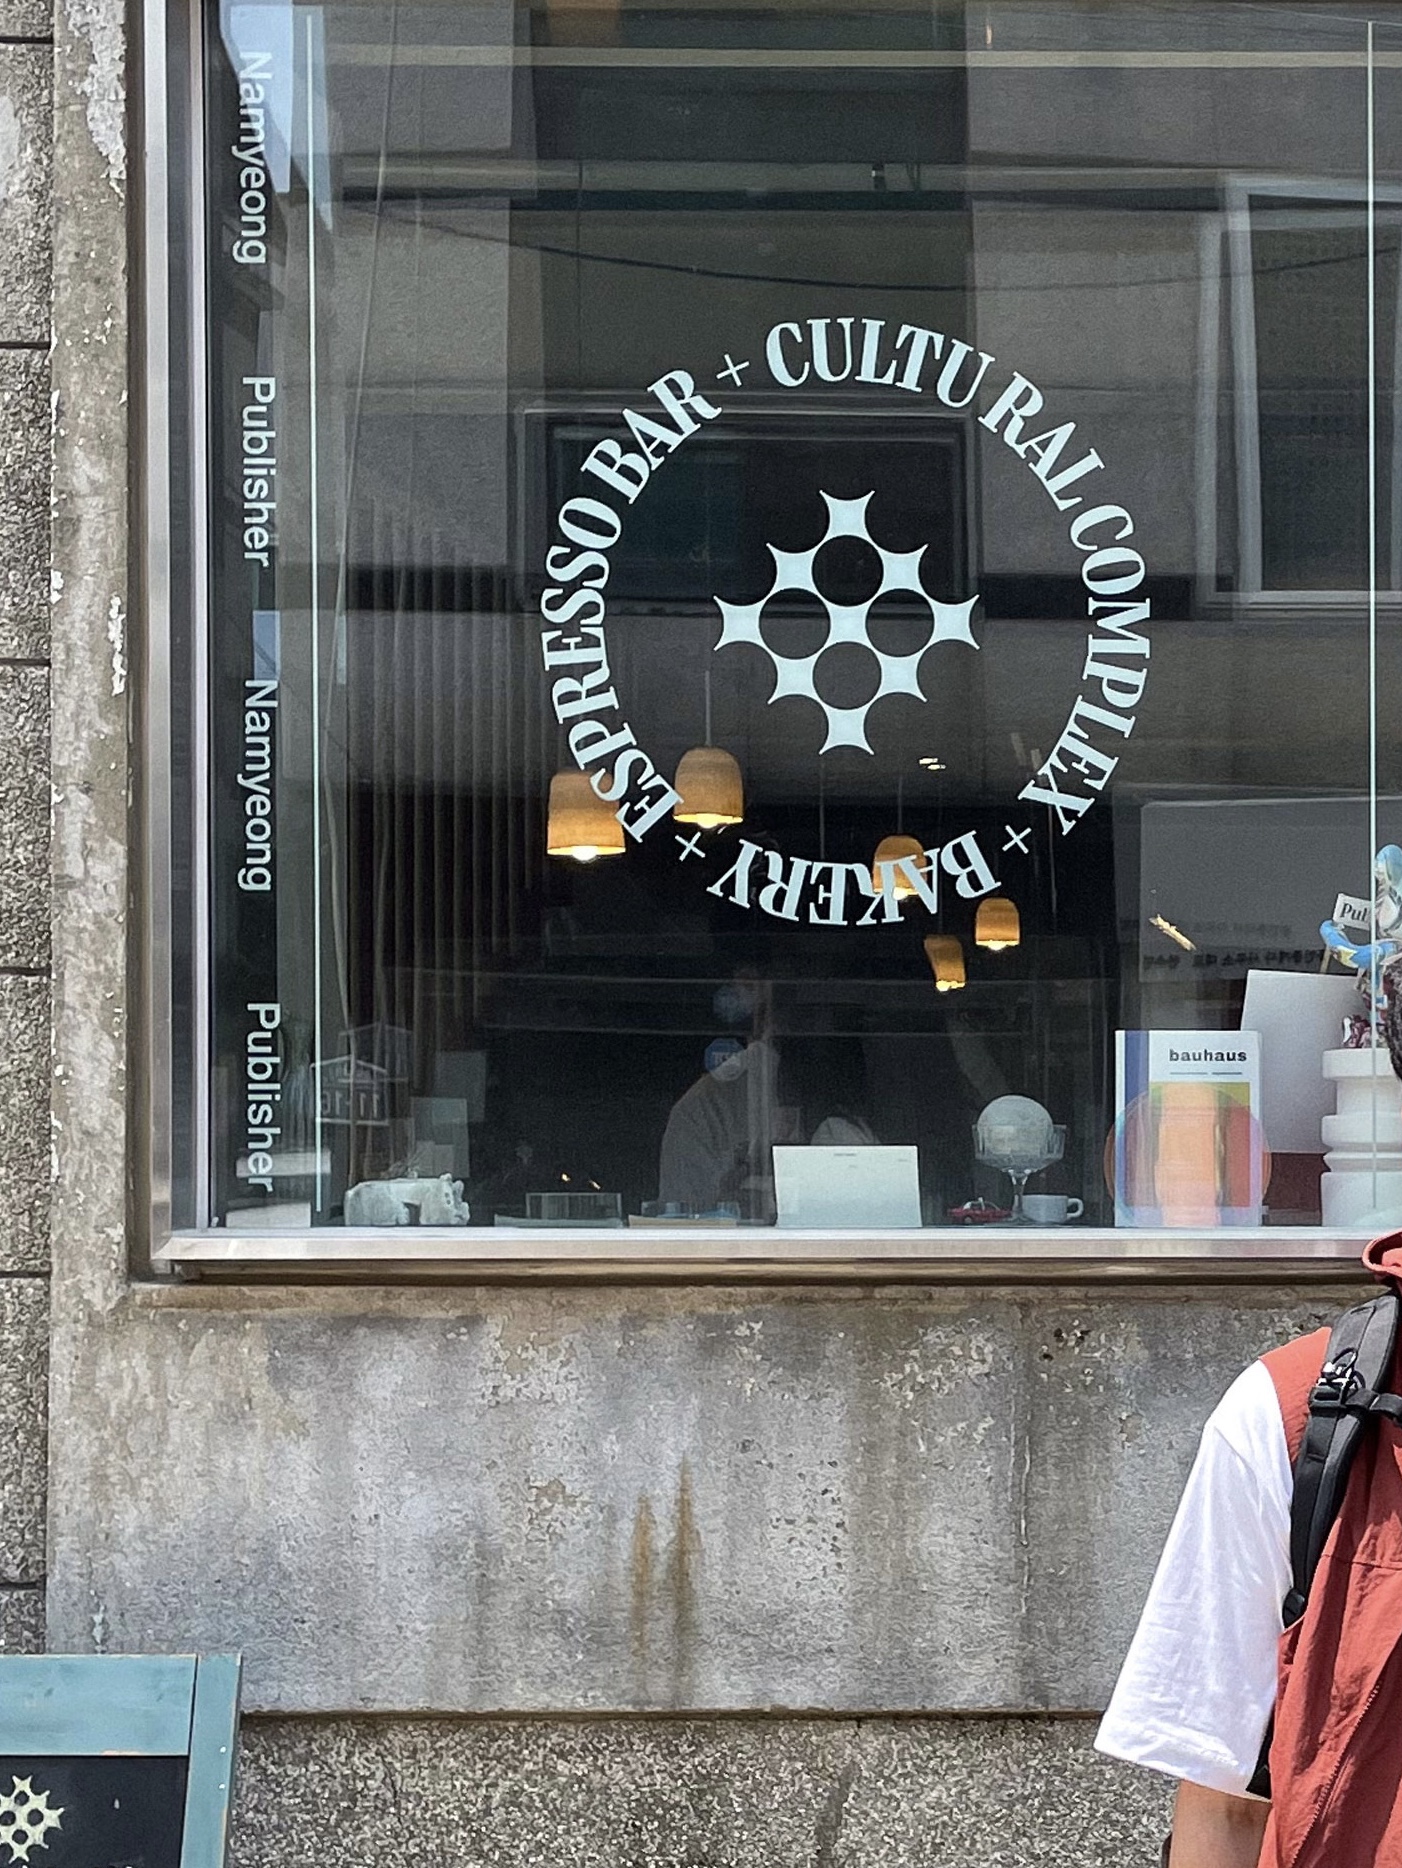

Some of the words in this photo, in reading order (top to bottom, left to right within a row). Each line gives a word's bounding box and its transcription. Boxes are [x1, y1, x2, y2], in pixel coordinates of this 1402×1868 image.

[231, 51, 273, 264] Namyeong
[241, 376, 276, 568] Publisher
[581, 369, 722, 504] BAR
[766, 317, 1105, 511] CULTURAL
[541, 496, 683, 842] ESPRESSO
[1017, 503, 1151, 835] COMPLEX
[237, 677, 280, 893] Namyeong
[706, 829, 1001, 926] BAKERY
[244, 1002, 281, 1193] Publisher
[1169, 1049, 1247, 1062] bauhaus
